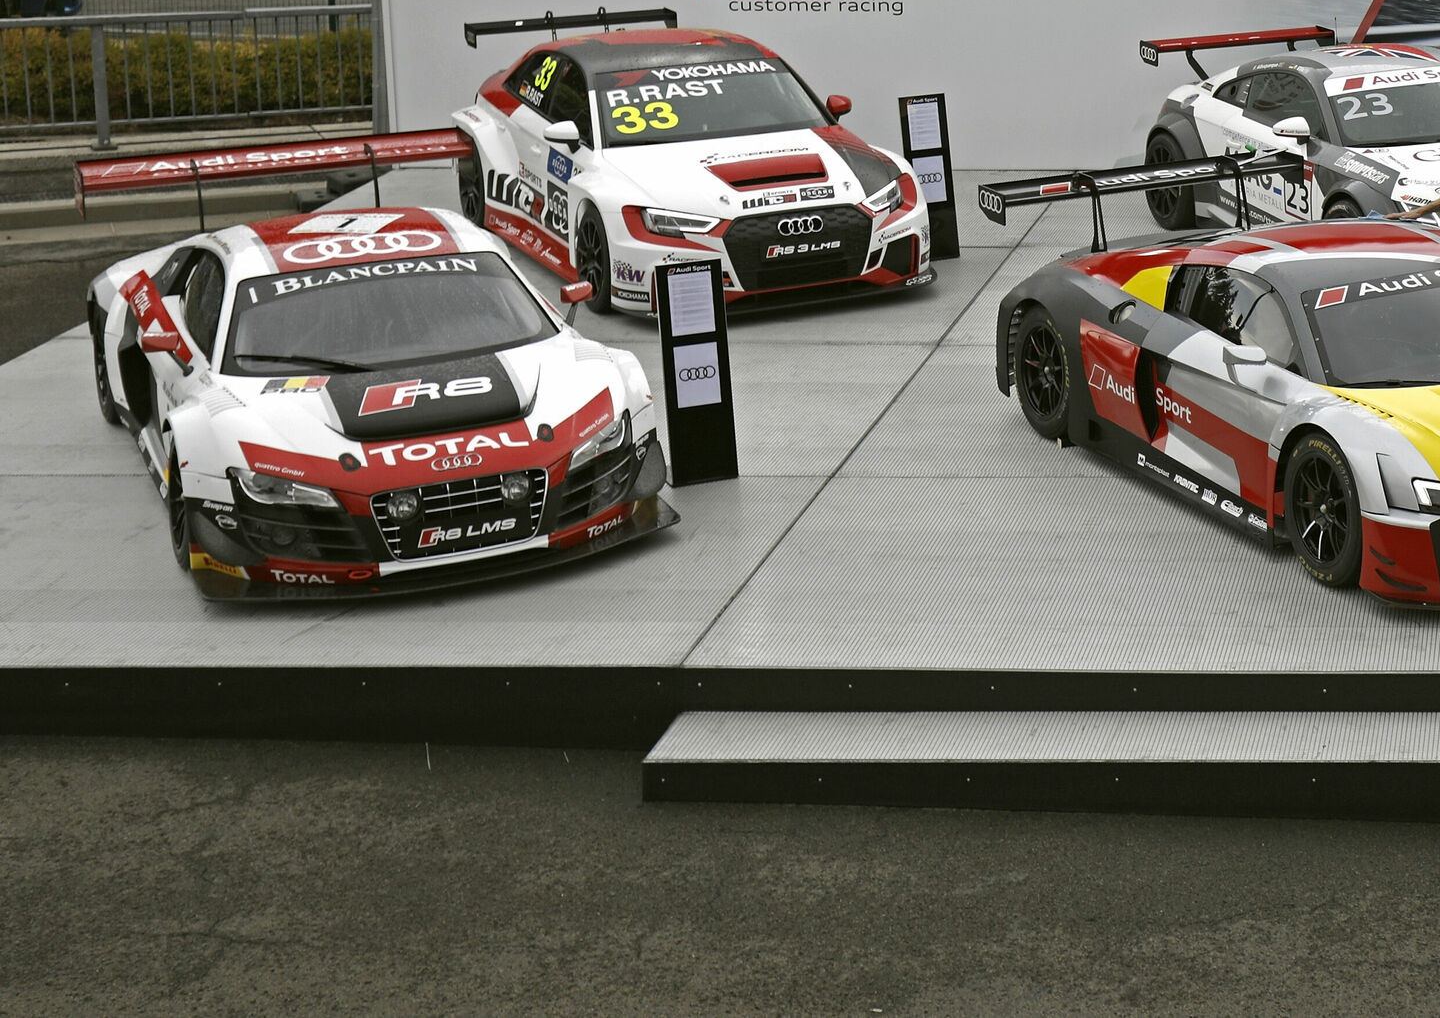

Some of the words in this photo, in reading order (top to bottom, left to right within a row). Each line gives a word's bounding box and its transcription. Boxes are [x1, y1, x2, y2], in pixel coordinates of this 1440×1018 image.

[728, 0, 832, 12] customer
[535, 56, 557, 90] 33
[651, 61, 776, 81] YOKOHAMA
[1372, 72, 1420, 85] Audi
[606, 79, 724, 108] R.RAST
[612, 102, 679, 134] 33
[1336, 93, 1394, 120] 23
[150, 154, 235, 171] Audi
[246, 145, 349, 163] Sport
[1259, 194, 1283, 211] METALL
[1287, 182, 1309, 214] 23
[337, 217, 358, 228] 1
[775, 245, 794, 257] RS
[798, 244, 808, 253] 3
[811, 241, 840, 251] LMS
[273, 258, 476, 296] BLANCPAIN
[692, 264, 712, 272] Sport
[618, 292, 648, 301] YOKOHAMA
[1359, 274, 1432, 297] Audi
[134, 285, 152, 317] TOTAL
[392, 377, 493, 406] R8
[1106, 374, 1135, 404] Audi
[1156, 388, 1192, 424] Sport
[368, 432, 530, 466] TOTAL
[1308, 439, 1342, 466] PIRELLI
[254, 462, 280, 472] quattro
[281, 467, 304, 478] GmbH
[203, 501, 234, 512] Snap-on
[430, 528, 462, 544] R8
[466, 518, 516, 537] LMS
[587, 515, 624, 538] TOTAL
[202, 556, 238, 575] PIRELLI
[270, 570, 335, 584] TOTAL
